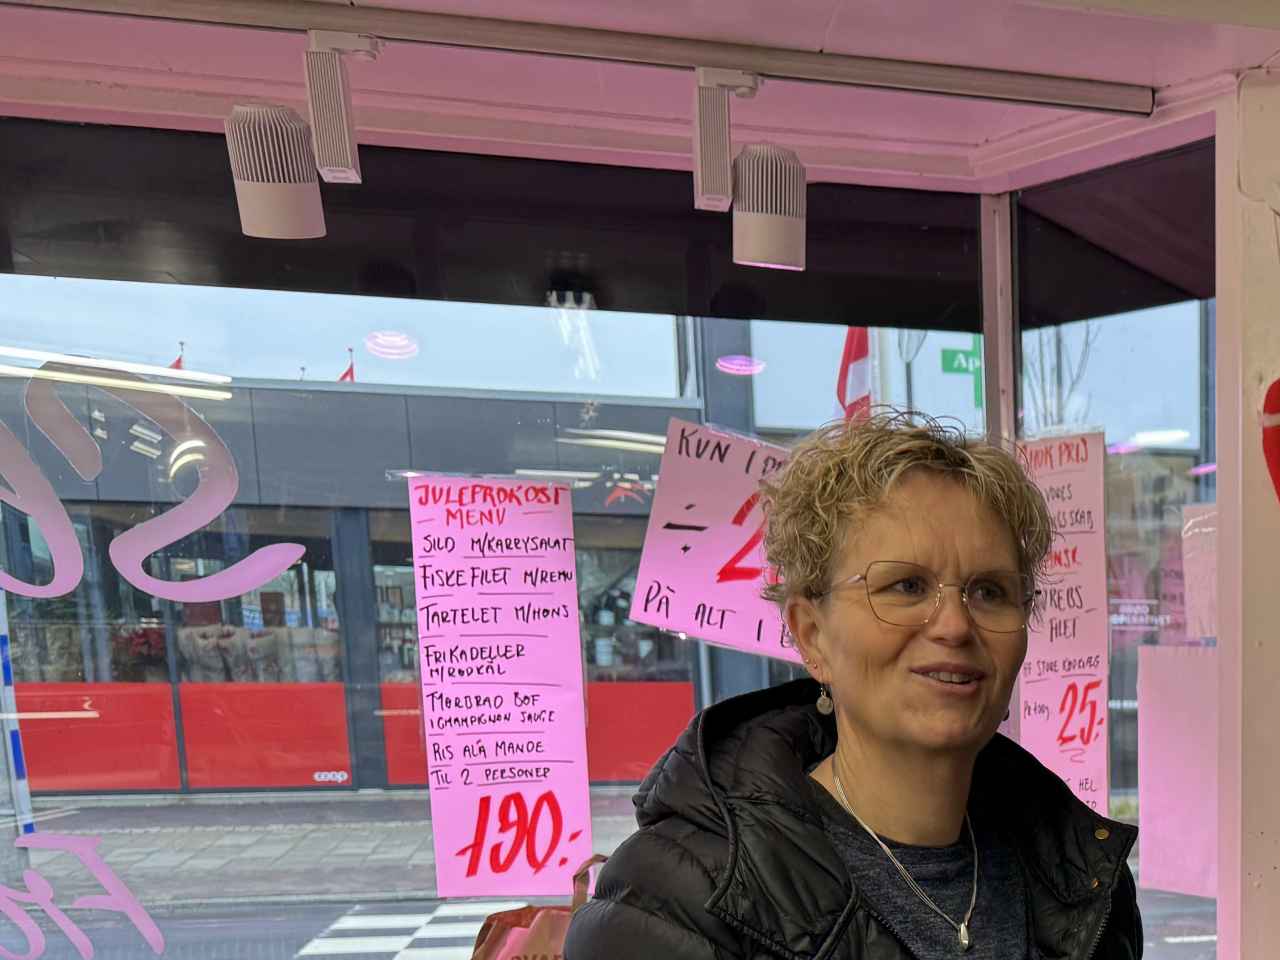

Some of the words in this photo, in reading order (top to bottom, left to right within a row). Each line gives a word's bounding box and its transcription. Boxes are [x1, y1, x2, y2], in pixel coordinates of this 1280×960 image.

[677, 427, 732, 464] KUN
[414, 483, 568, 507] JULEFROKOST
[423, 534, 456, 553] SILD
[419, 603, 503, 632] TARTELET
[694, 603, 736, 630] ALT
[424, 643, 526, 667] FRIKADELLER
[460, 768, 473, 786] 2
[484, 767, 551, 781] PERSONER
